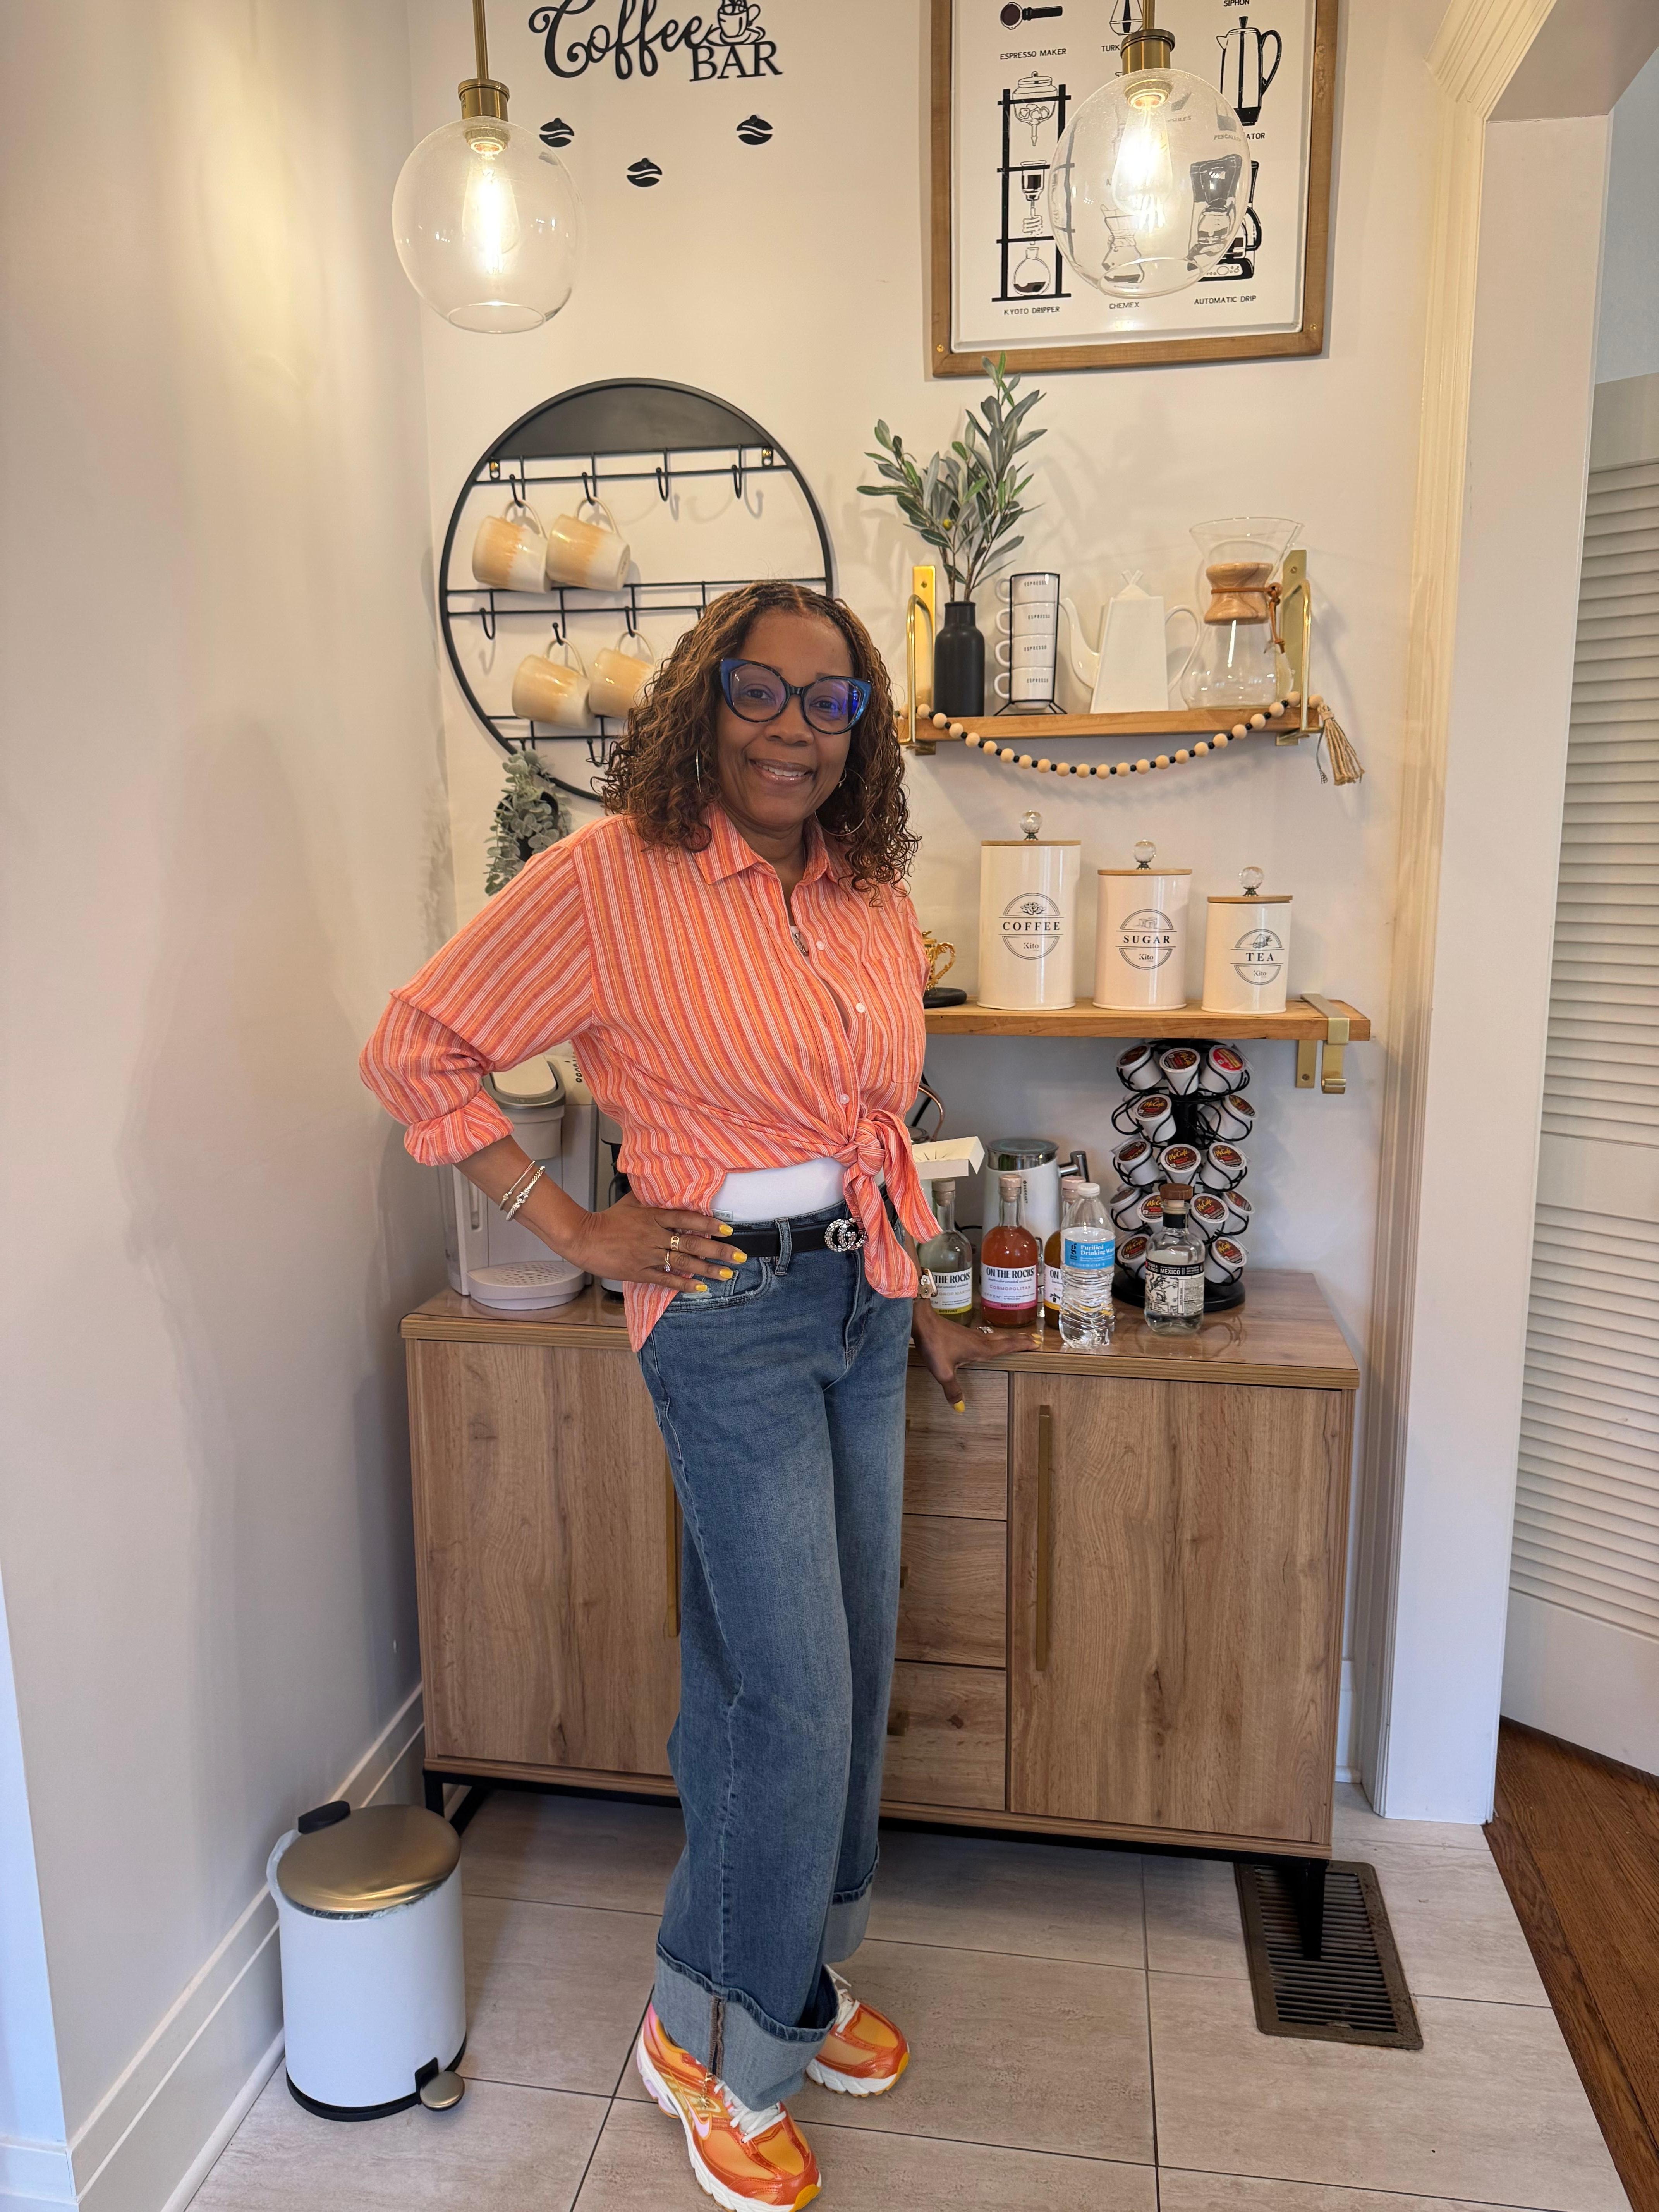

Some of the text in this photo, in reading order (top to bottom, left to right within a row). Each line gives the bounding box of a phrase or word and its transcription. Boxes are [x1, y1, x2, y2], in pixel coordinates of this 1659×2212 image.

[529, 0, 703, 79] Coffee
[1000, 51, 1037, 60] ESPRESSO
[689, 41, 783, 81] BAR
[1194, 297, 1237, 305] AUTOMATIC
[1003, 922, 1060, 931] COFFEE
[1123, 935, 1170, 943] SUGAR
[1246, 953, 1274, 961] TEA
[986, 1267, 1034, 1278] ON THE ROCKS
[1050, 1270, 1059, 1279] ON
[934, 1272, 970, 1283] THE ROCKS
